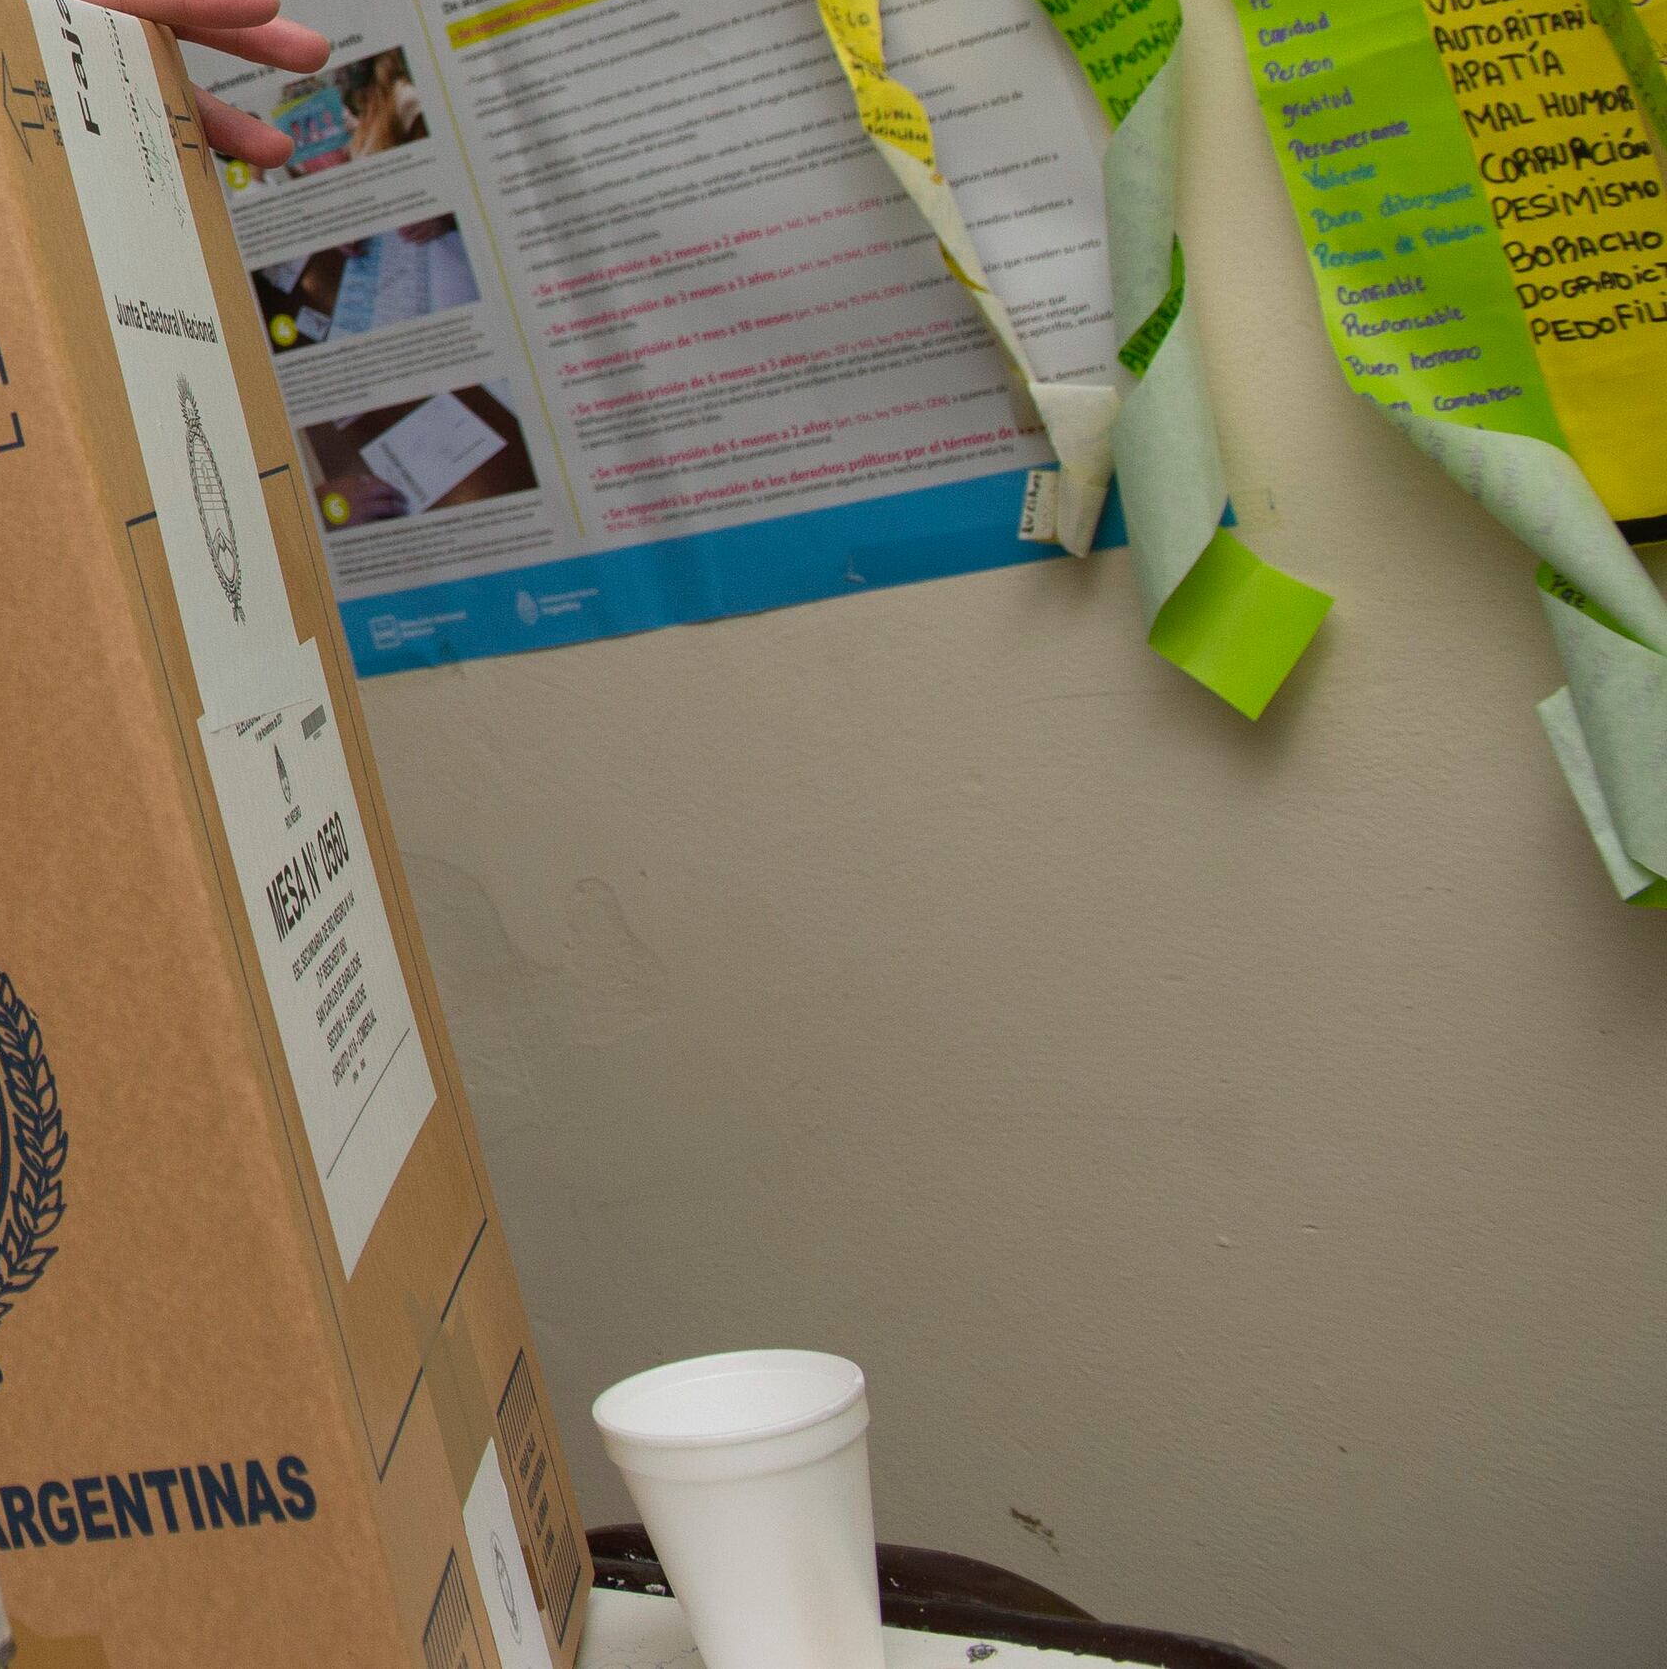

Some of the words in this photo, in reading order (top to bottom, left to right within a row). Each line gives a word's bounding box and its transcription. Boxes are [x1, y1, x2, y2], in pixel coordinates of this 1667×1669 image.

[1448, 40, 1566, 96] APATÍA
[1460, 100, 1536, 139] MAL
[1543, 83, 1637, 117] HUMOR
[113, 293, 144, 330] Junta
[139, 298, 183, 338] Electoral
[178, 308, 220, 345] Nacional
[267, 855, 312, 944] MESA
[317, 810, 351, 883] 0560
